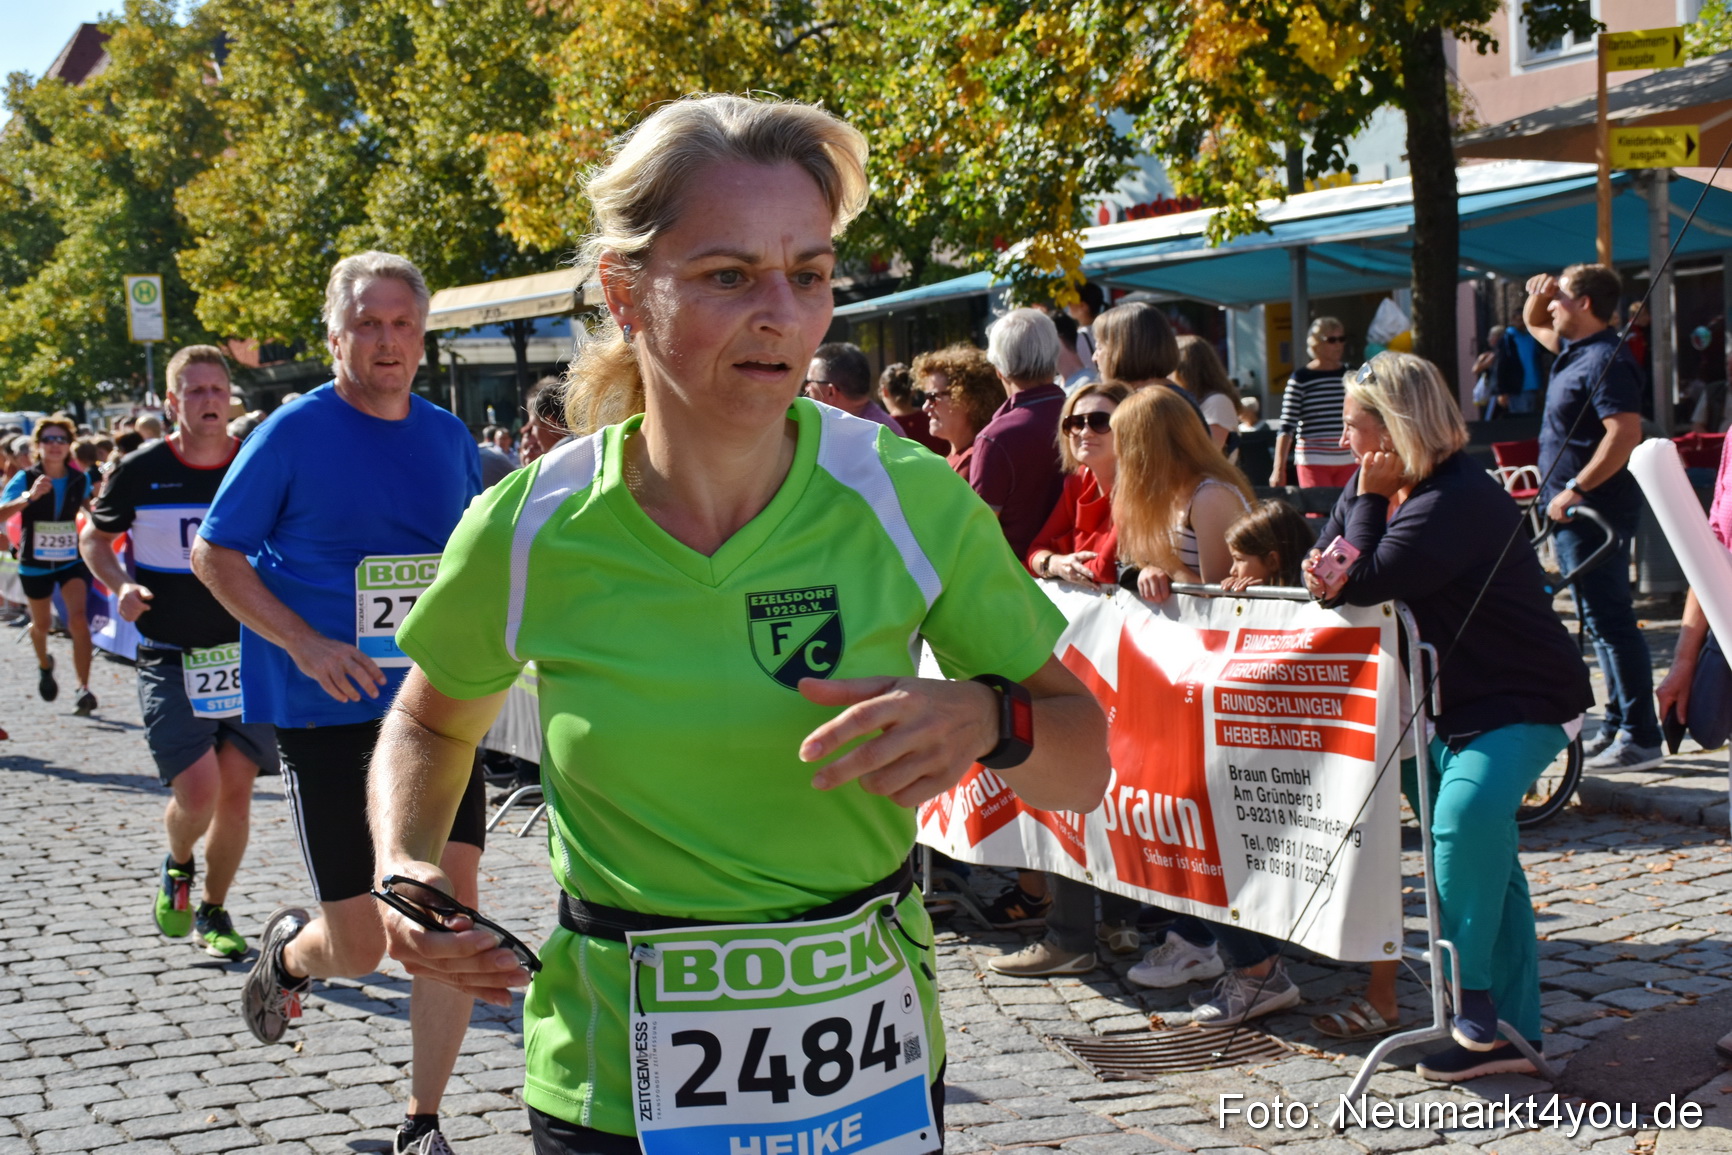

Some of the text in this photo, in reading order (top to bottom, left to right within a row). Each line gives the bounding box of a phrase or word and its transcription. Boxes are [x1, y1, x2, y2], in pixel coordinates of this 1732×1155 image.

[1617, 53, 1655, 67] ausgabe
[1632, 149, 1667, 162] ausgabe
[40, 535, 73, 547] 2293
[367, 562, 439, 583] BOC
[750, 588, 833, 606] EZELSDORF
[373, 595, 418, 629] 27
[765, 604, 797, 616] 1923
[769, 621, 792, 656] F
[193, 647, 241, 665] BOC
[804, 640, 831, 672] C
[196, 668, 241, 693] 228
[1227, 663, 1350, 682] VERZURRSYSTEME
[1221, 693, 1343, 716] RUNDSCHLINGEN
[1223, 725, 1322, 748] HEBEBÄNDER
[1229, 765, 1311, 785] Braun GmbH
[1234, 785, 1322, 812] Am Grünberg 8
[1236, 805, 1286, 825] D-92318
[1241, 834, 1264, 851] Tel.
[1267, 836, 1296, 857] 09181
[1305, 844, 1332, 866] 2307-0
[1143, 847, 1223, 877] Sicher ist sicher
[1246, 854, 1266, 872] Fax
[1269, 858, 1295, 878] 09181
[659, 918, 893, 997] BOCK
[904, 993, 912, 1008] D
[651, 1020, 659, 1067] ZEITMESSUNG
[671, 1000, 900, 1108] 2484
[729, 1112, 863, 1155] HEIKE
